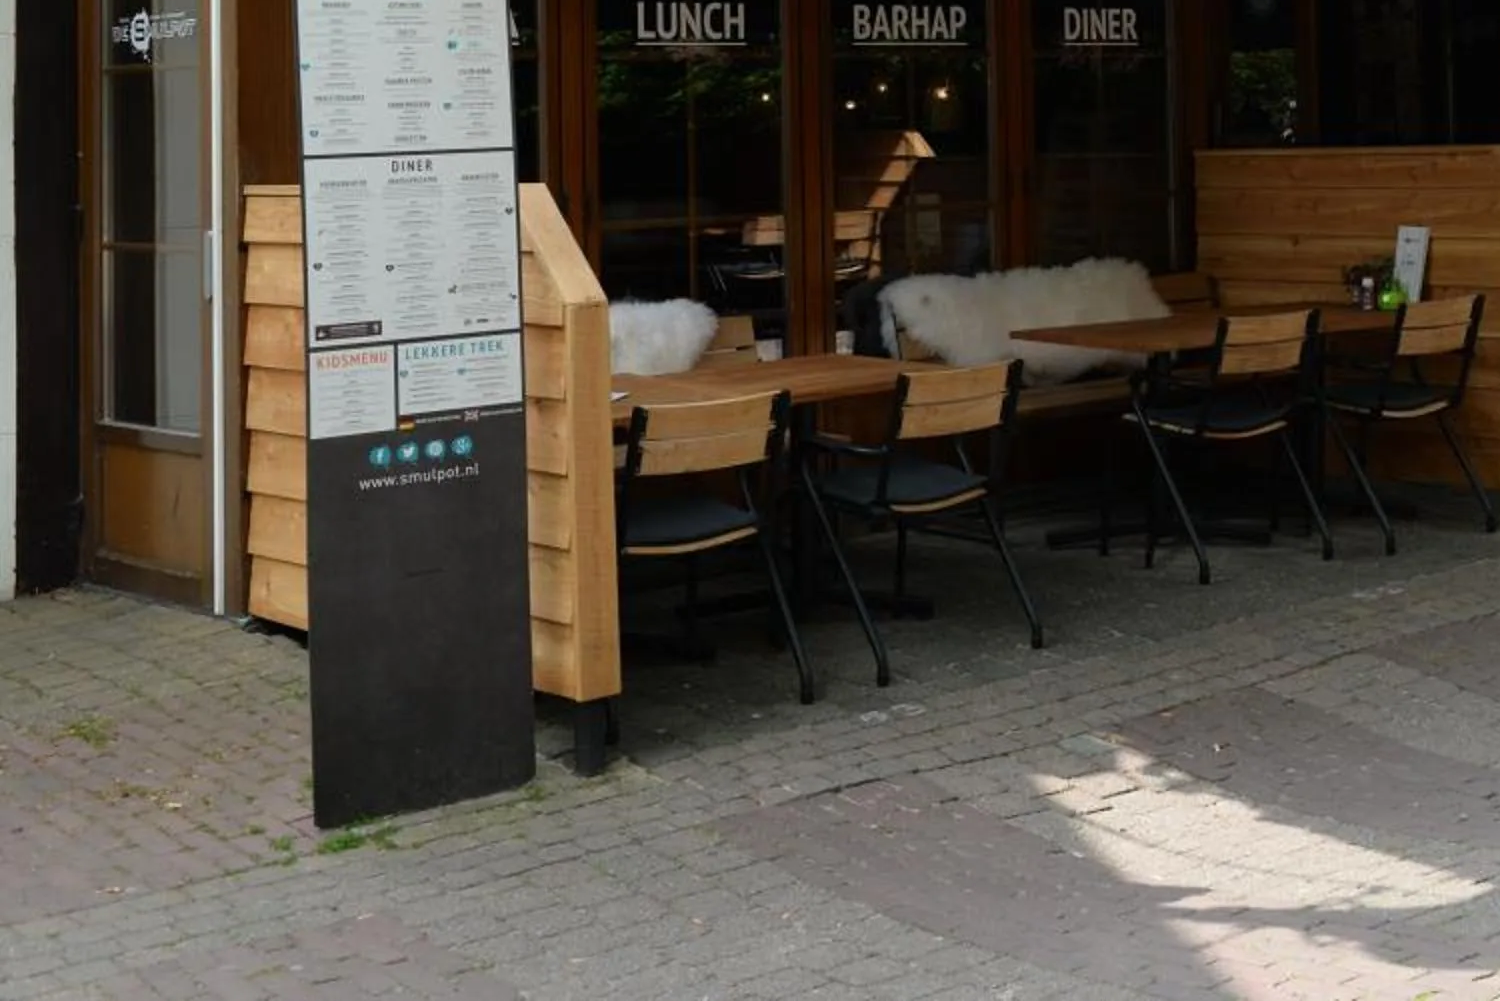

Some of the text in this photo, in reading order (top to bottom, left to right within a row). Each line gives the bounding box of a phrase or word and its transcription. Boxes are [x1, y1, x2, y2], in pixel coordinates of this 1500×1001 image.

[636, 1, 745, 41] LUNCH
[852, 5, 967, 41] BARHAP
[1063, 7, 1138, 41] DINER
[391, 159, 433, 173] DINER
[316, 351, 388, 370] KIDSMENU
[405, 339, 503, 360] LEKKERE TREK
[359, 464, 480, 492] www.smulpot.nl
